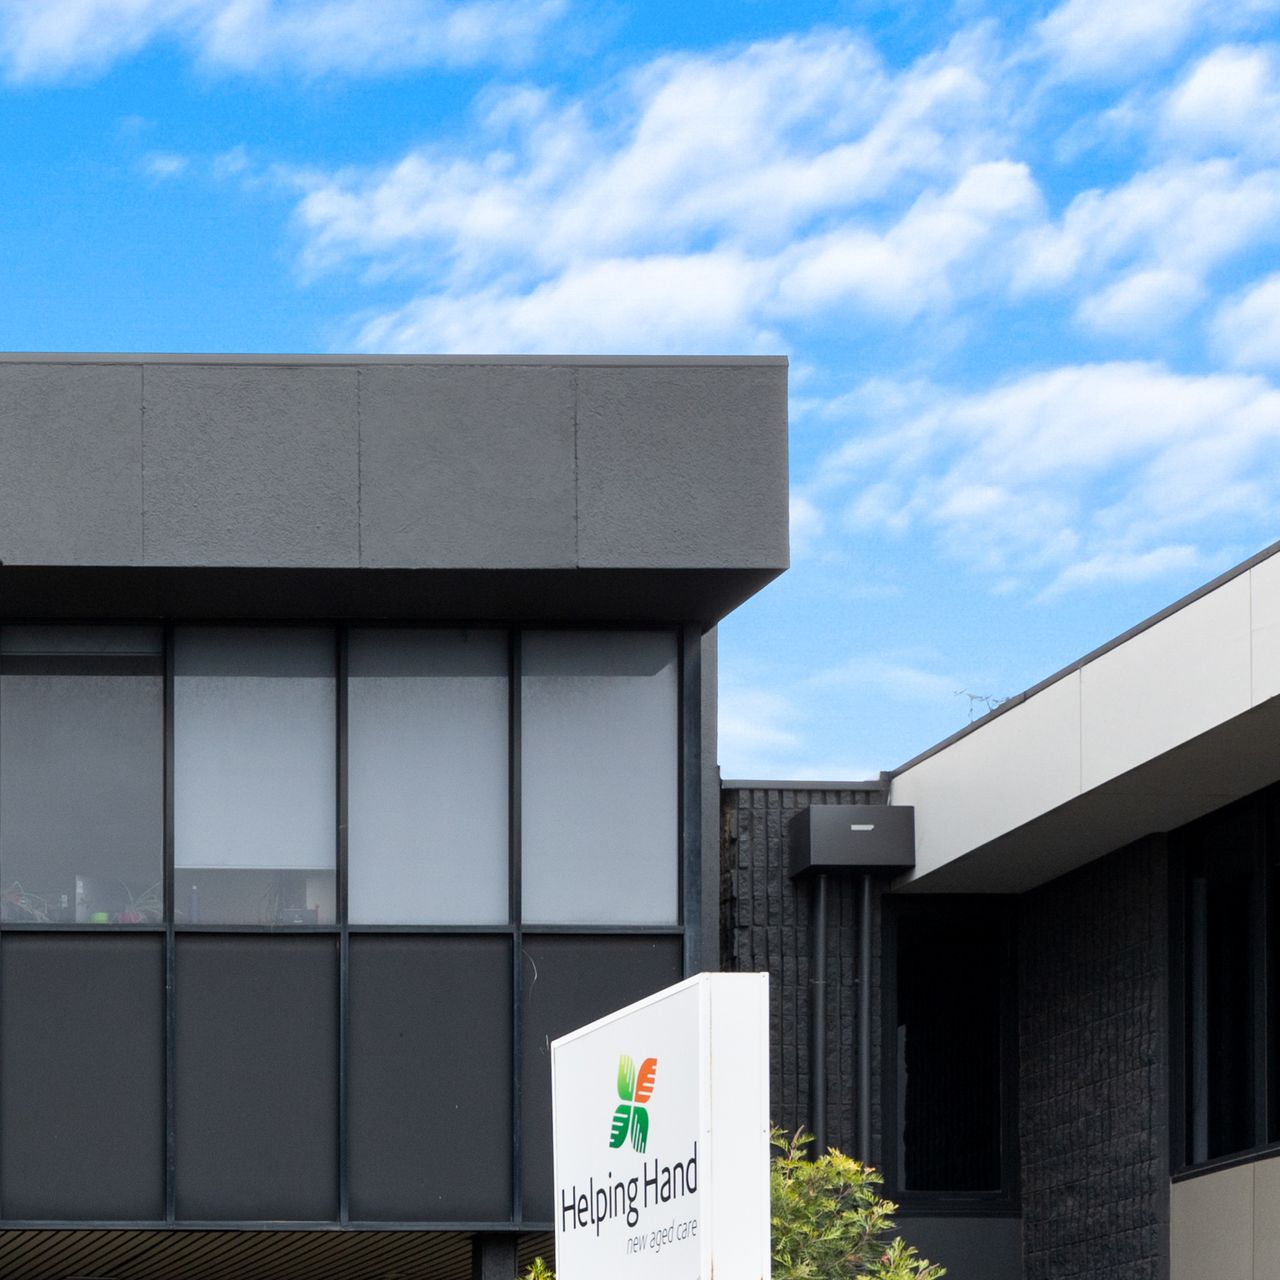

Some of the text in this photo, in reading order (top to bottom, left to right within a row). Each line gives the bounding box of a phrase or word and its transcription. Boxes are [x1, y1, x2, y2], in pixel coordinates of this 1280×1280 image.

[561, 1141, 698, 1237] Helping Hand
[626, 1218, 698, 1255] new aged care
